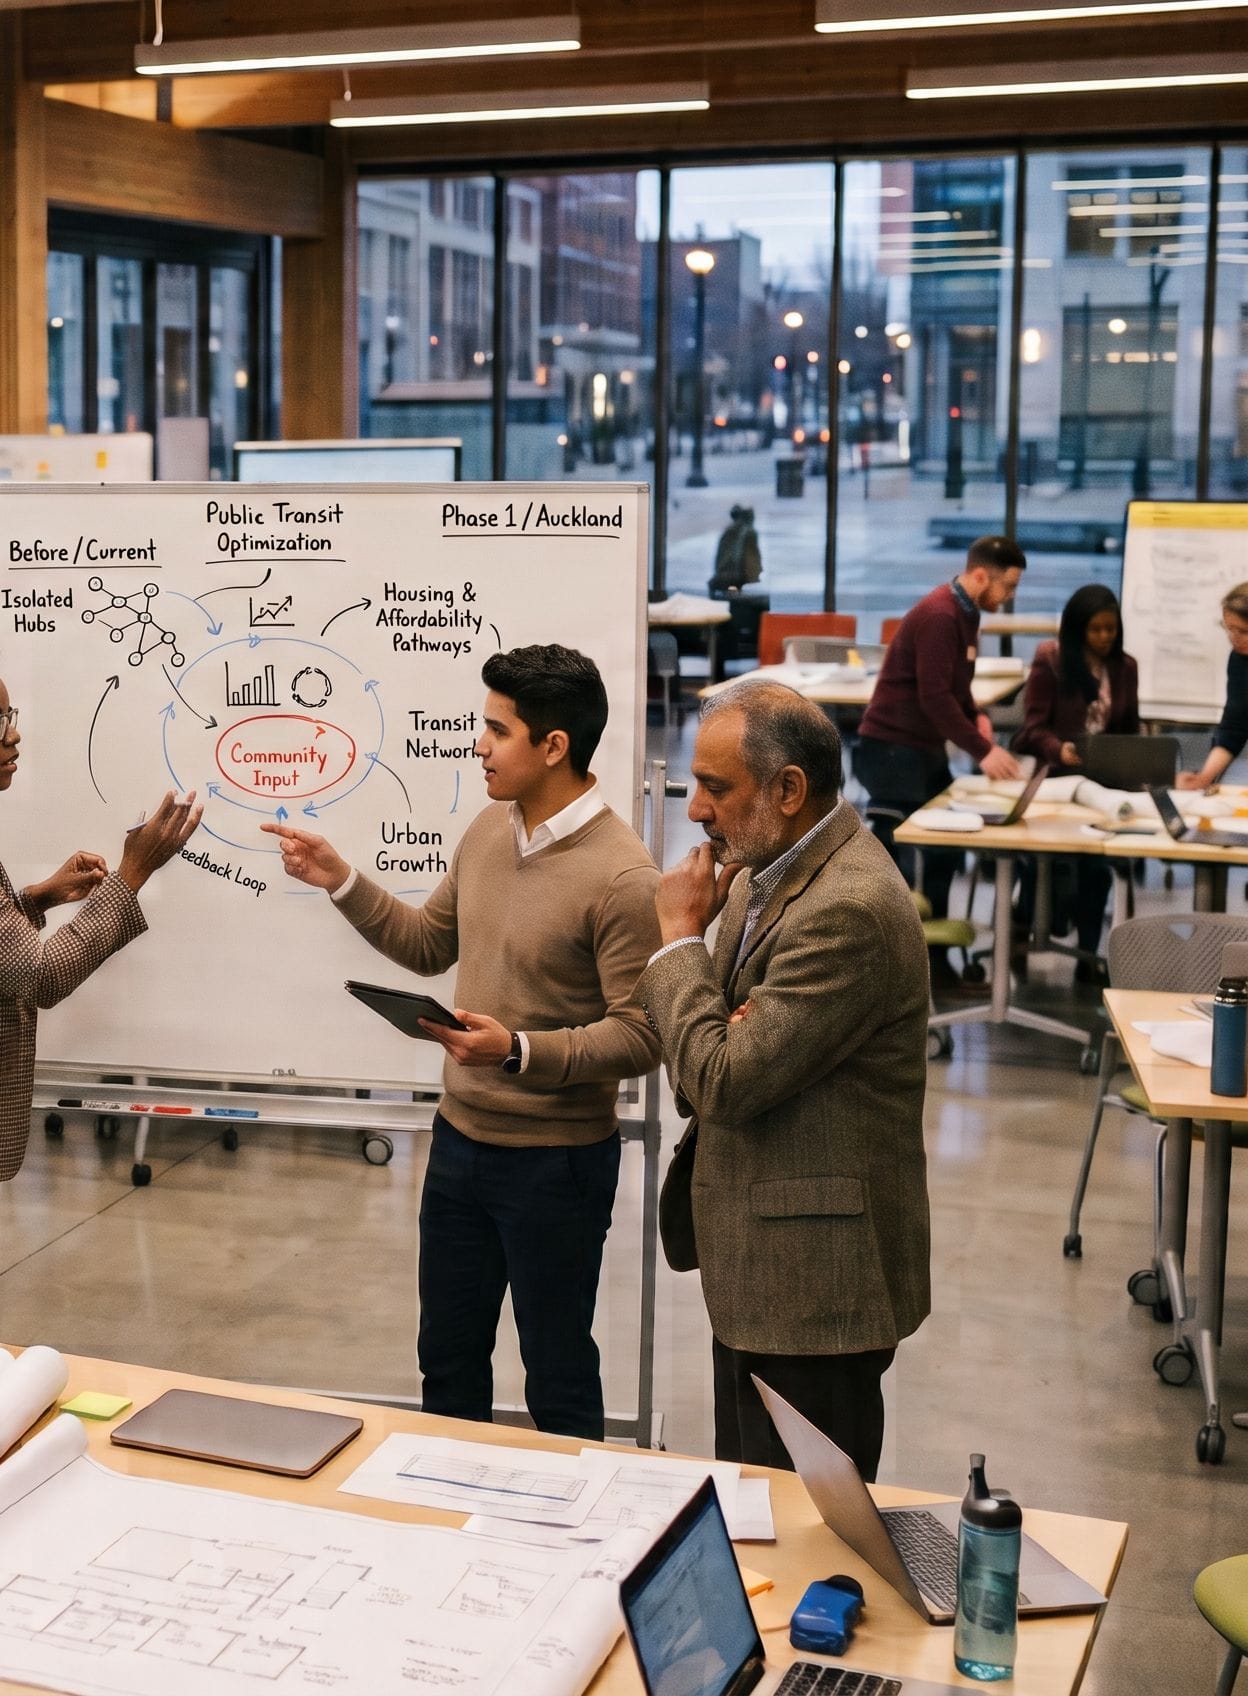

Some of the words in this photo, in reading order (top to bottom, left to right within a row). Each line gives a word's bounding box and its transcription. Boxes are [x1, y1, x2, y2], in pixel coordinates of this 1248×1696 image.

[206, 500, 265, 525] Public
[272, 502, 344, 524] Transit
[442, 503, 498, 527] Phase
[217, 531, 332, 558] Optimization
[0, 587, 73, 609] Isolated
[384, 581, 454, 608] Housing
[462, 581, 477, 602] &
[14, 613, 56, 633] Hubs
[375, 608, 483, 635] Affordability
[392, 632, 472, 659] Pathways
[408, 710, 477, 732] Transit
[231, 742, 328, 774] Community
[253, 769, 300, 792] Input
[381, 821, 442, 846] Urban
[177, 843, 232, 880] eedback
[234, 866, 267, 898] Loop
[376, 851, 447, 873] Growth
